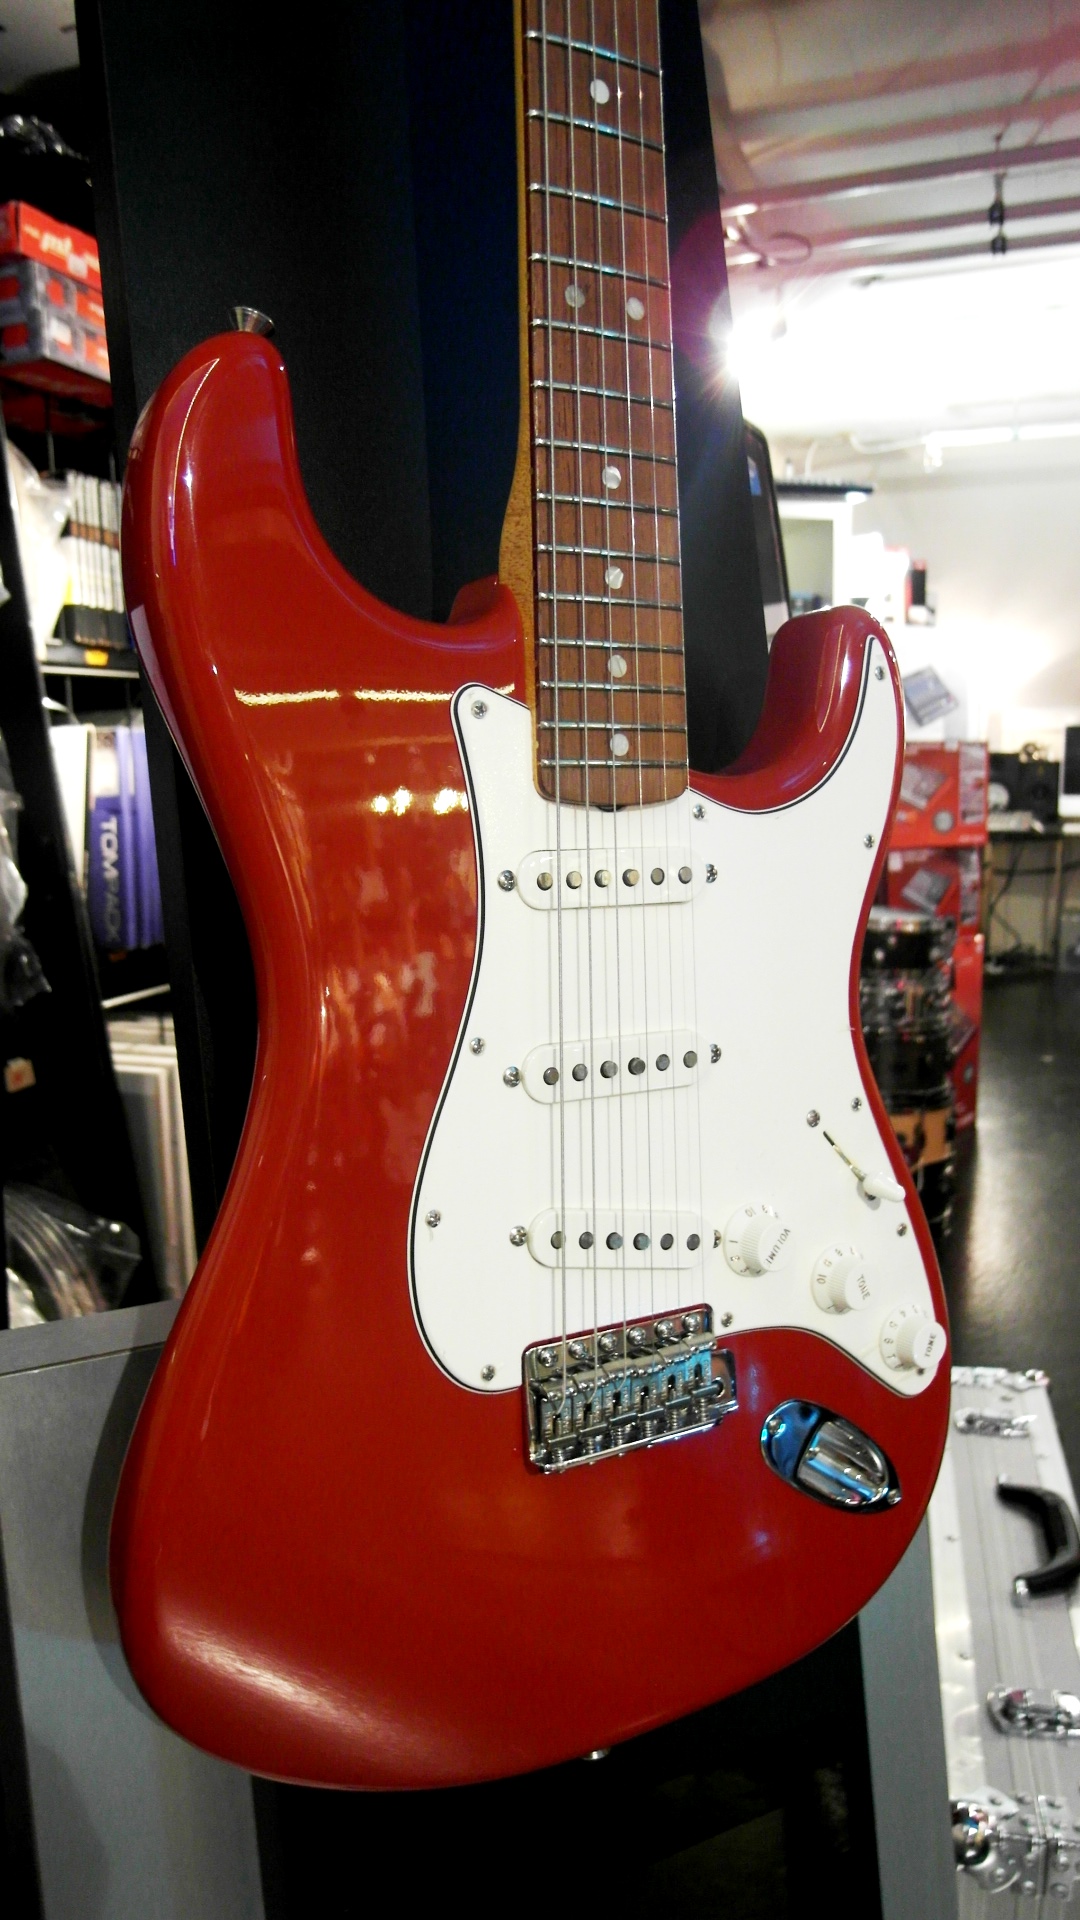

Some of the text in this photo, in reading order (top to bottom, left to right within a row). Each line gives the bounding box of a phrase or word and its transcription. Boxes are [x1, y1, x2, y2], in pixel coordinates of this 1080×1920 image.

[816, 1273, 827, 1285] 10
[857, 1273, 871, 1301] TONE
[924, 1332, 937, 1358] TONE
